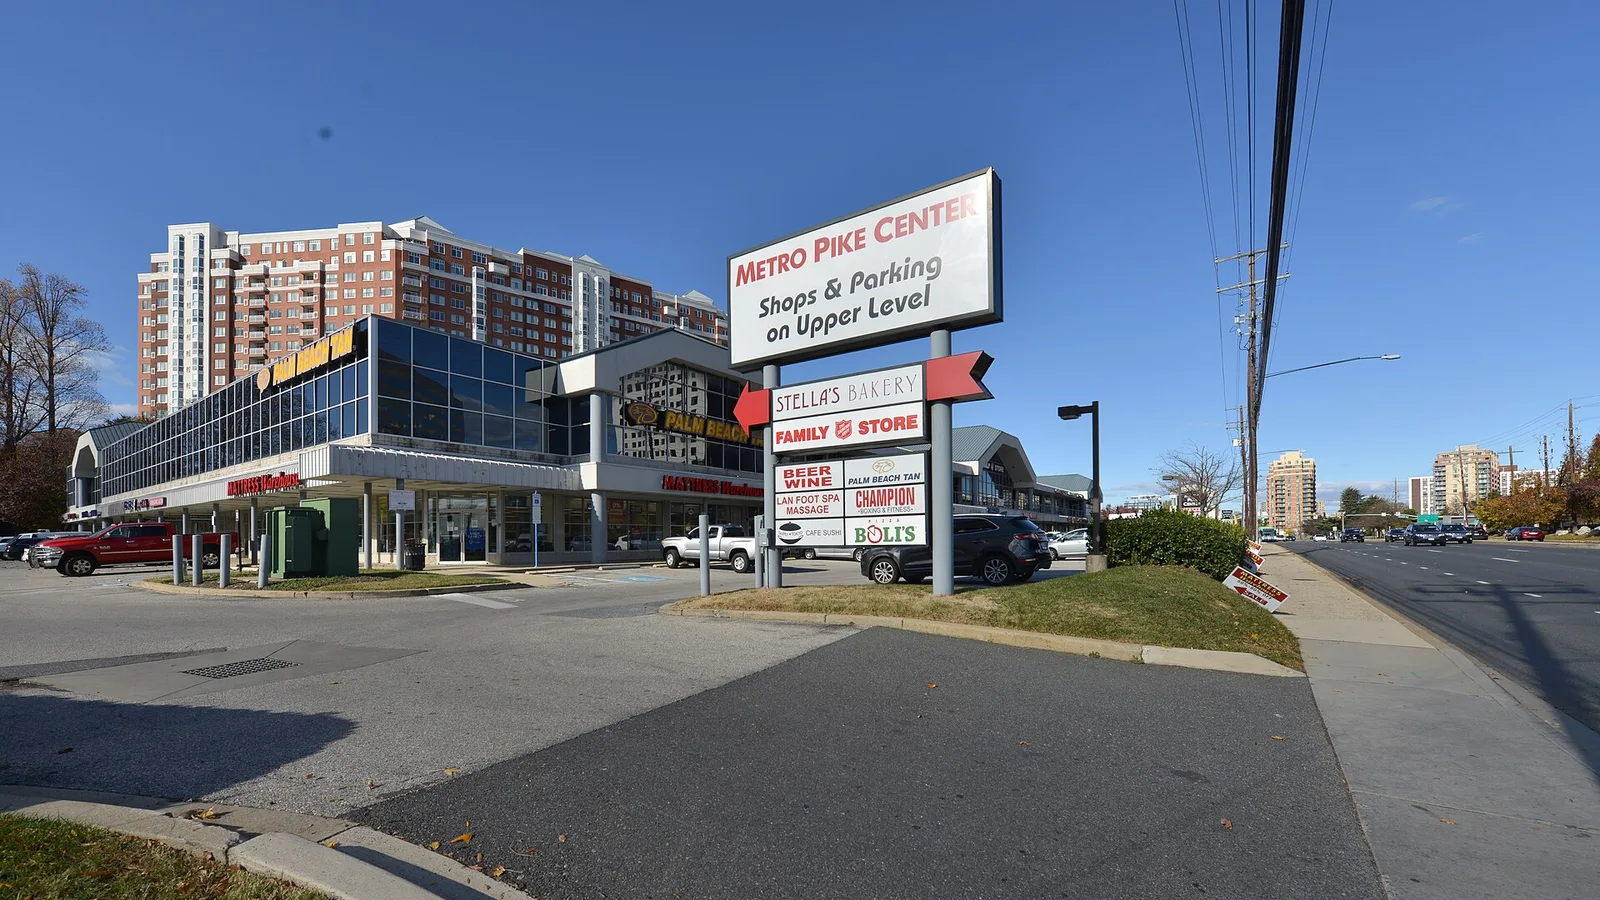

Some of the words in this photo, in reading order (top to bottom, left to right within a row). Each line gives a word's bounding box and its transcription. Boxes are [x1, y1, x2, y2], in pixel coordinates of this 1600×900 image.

[735, 247, 807, 287] METRO
[814, 227, 866, 263] PIKE
[874, 193, 977, 243] CENTER
[759, 288, 817, 319] Shops
[824, 277, 842, 300] &
[850, 255, 942, 294] Parking
[766, 324, 790, 343] on
[796, 305, 861, 339] Upper
[869, 283, 931, 319] Level
[776, 386, 840, 413] STELLA'S
[848, 373, 917, 402] BAKERY
[665, 411, 705, 434] PALM
[776, 425, 830, 445] FAMILY
[858, 414, 918, 436] STORE
[783, 465, 831, 479] BEER
[784, 476, 833, 489] WINE
[848, 477, 870, 485] PALM
[872, 474, 900, 483] BEACH
[903, 472, 921, 481] TAN
[227, 476, 259, 496] MATTRESS
[261, 471, 299, 490] Warehouse
[776, 494, 794, 505] LAN
[796, 494, 819, 504] FOOT
[822, 493, 840, 503] SPA
[855, 487, 915, 508] CHAMPION
[786, 505, 829, 515] MASSAGE
[854, 525, 916, 544] BOLI'S
[1240, 571, 1281, 596] MATTRESS
[1243, 590, 1265, 602] SALE
